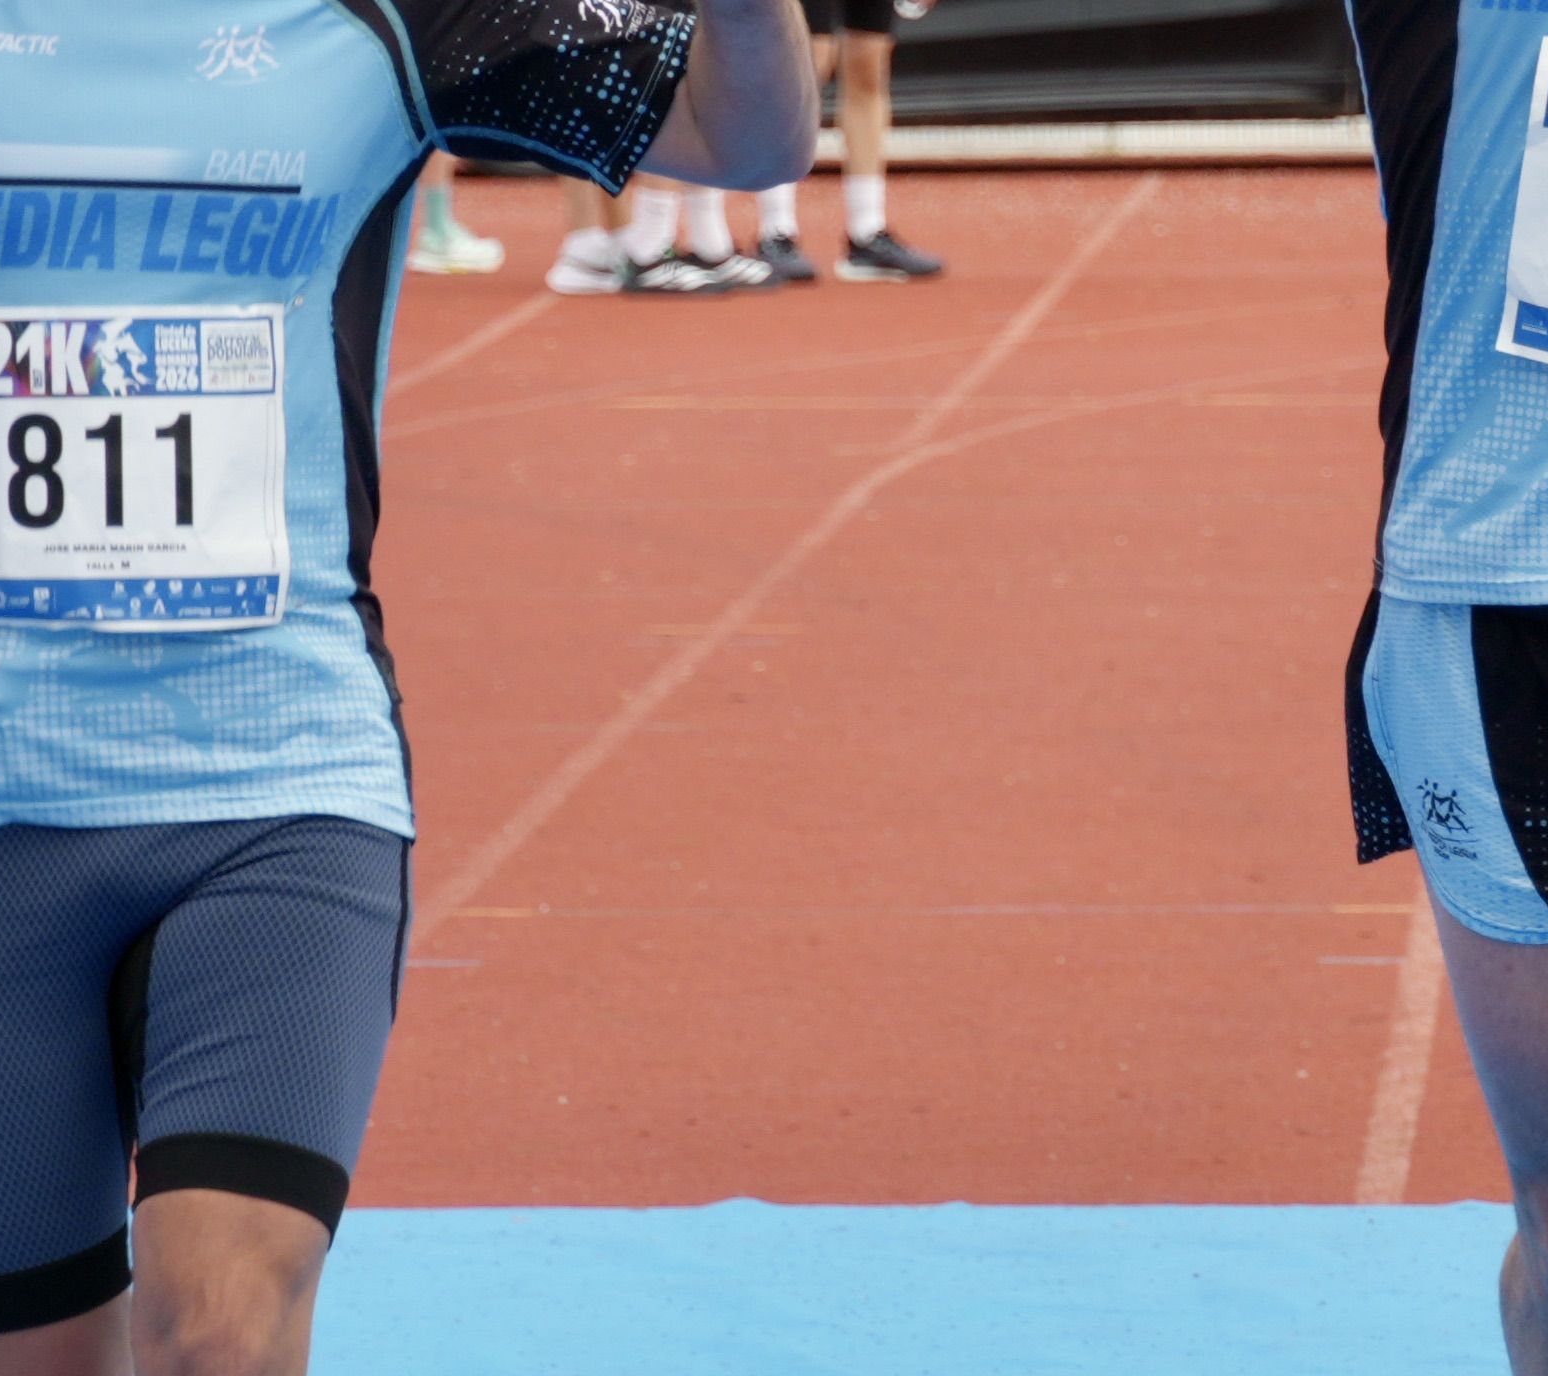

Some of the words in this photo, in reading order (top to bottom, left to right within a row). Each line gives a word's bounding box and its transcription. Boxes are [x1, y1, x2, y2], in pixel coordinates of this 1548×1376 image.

[204, 147, 306, 184] BAENA
[155, 366, 200, 392] 2026
[7, 410, 194, 529] 811
